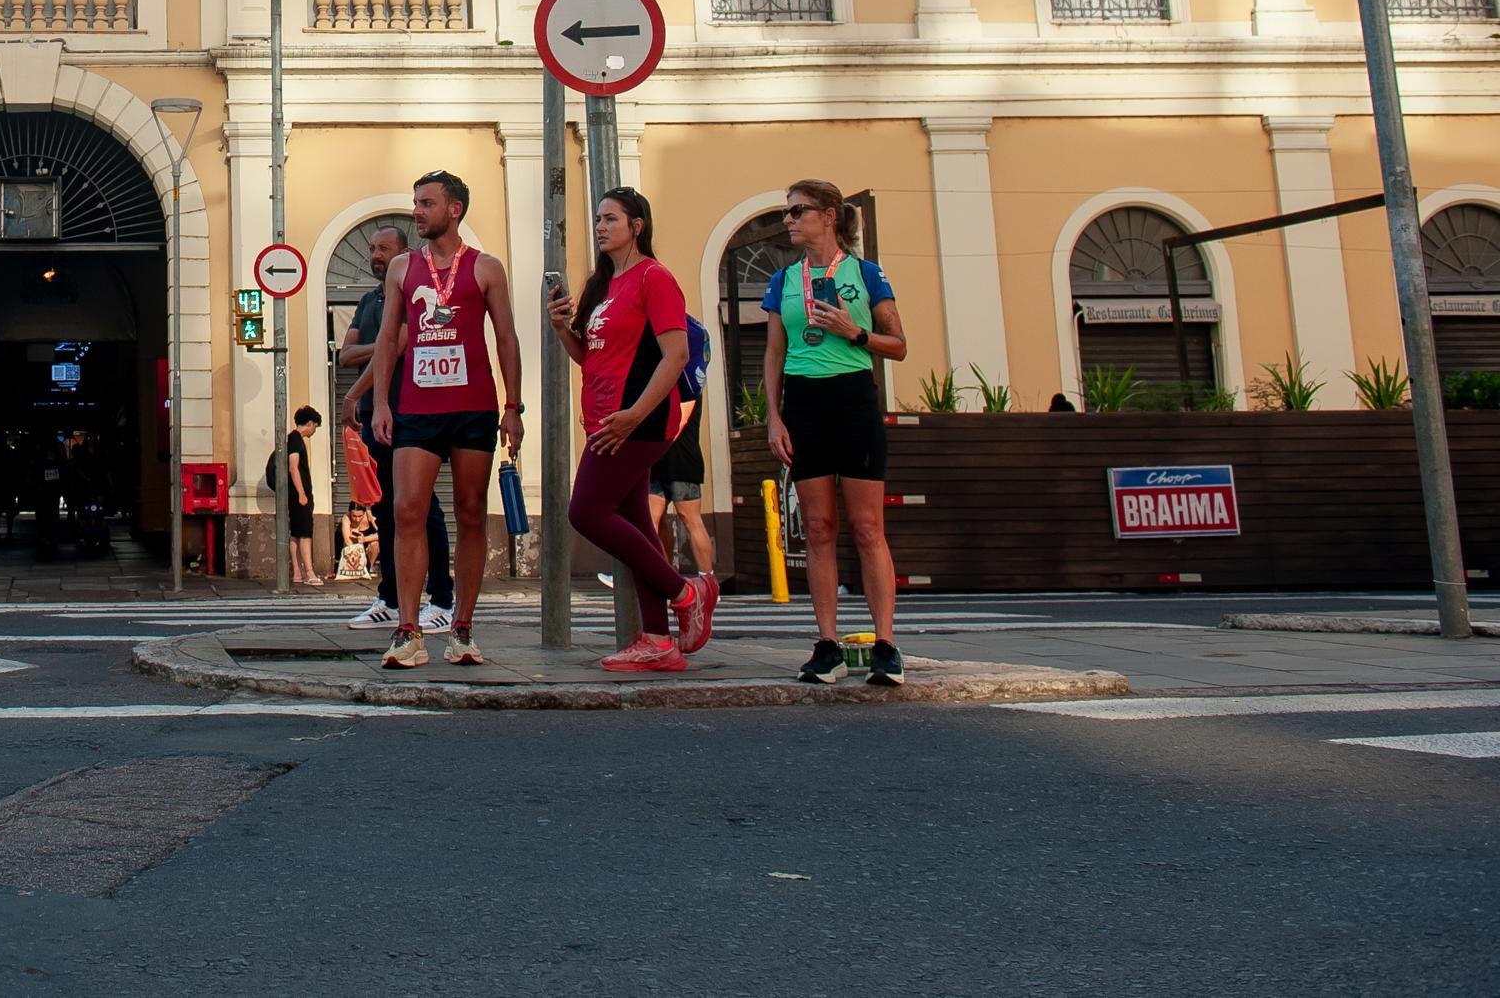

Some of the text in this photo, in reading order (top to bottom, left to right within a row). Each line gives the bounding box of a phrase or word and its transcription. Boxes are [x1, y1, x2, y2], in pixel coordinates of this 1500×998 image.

[238, 291, 260, 313] 43
[1430, 299, 1486, 312] estaurante
[1086, 306, 1151, 321] Restaurante
[417, 331, 457, 343] PEGASUS
[417, 357, 461, 376] 2107
[1146, 471, 1202, 484] Chopp
[1122, 492, 1231, 528] BRAHMA
